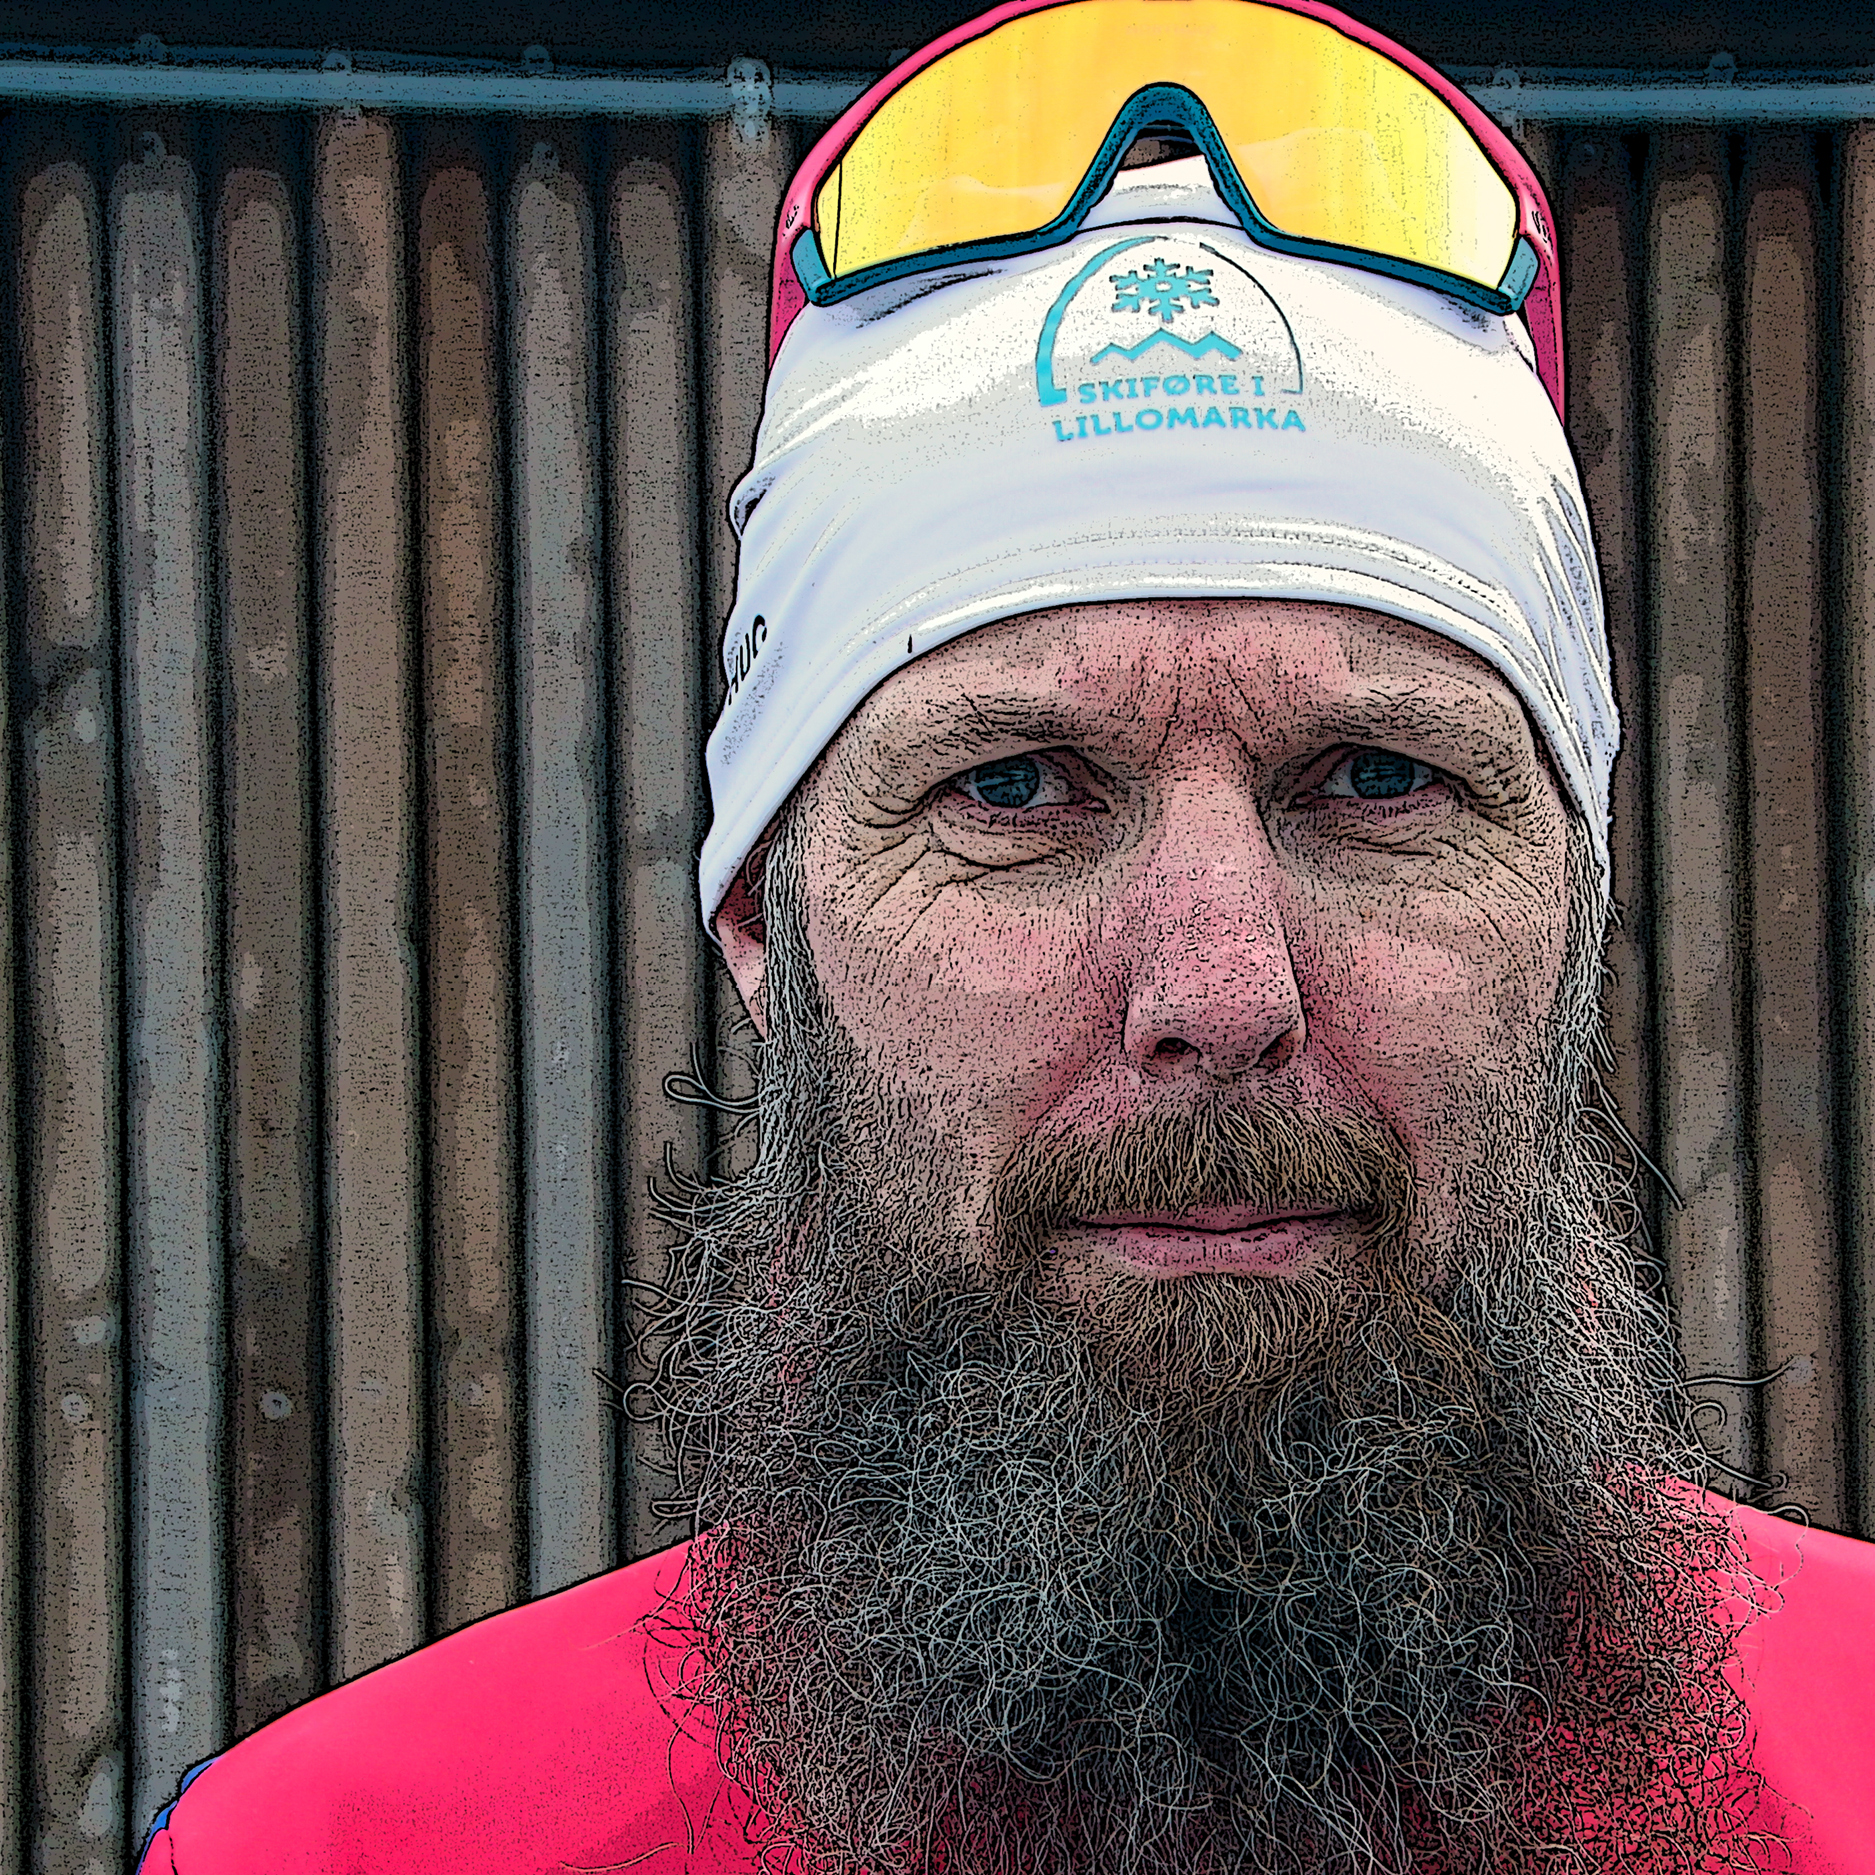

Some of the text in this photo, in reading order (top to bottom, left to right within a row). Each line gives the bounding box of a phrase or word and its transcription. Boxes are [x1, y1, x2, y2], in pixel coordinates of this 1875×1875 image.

[1078, 373, 1266, 404] SKIFØRE I
[1052, 406, 1306, 442] LILLOMARKA
